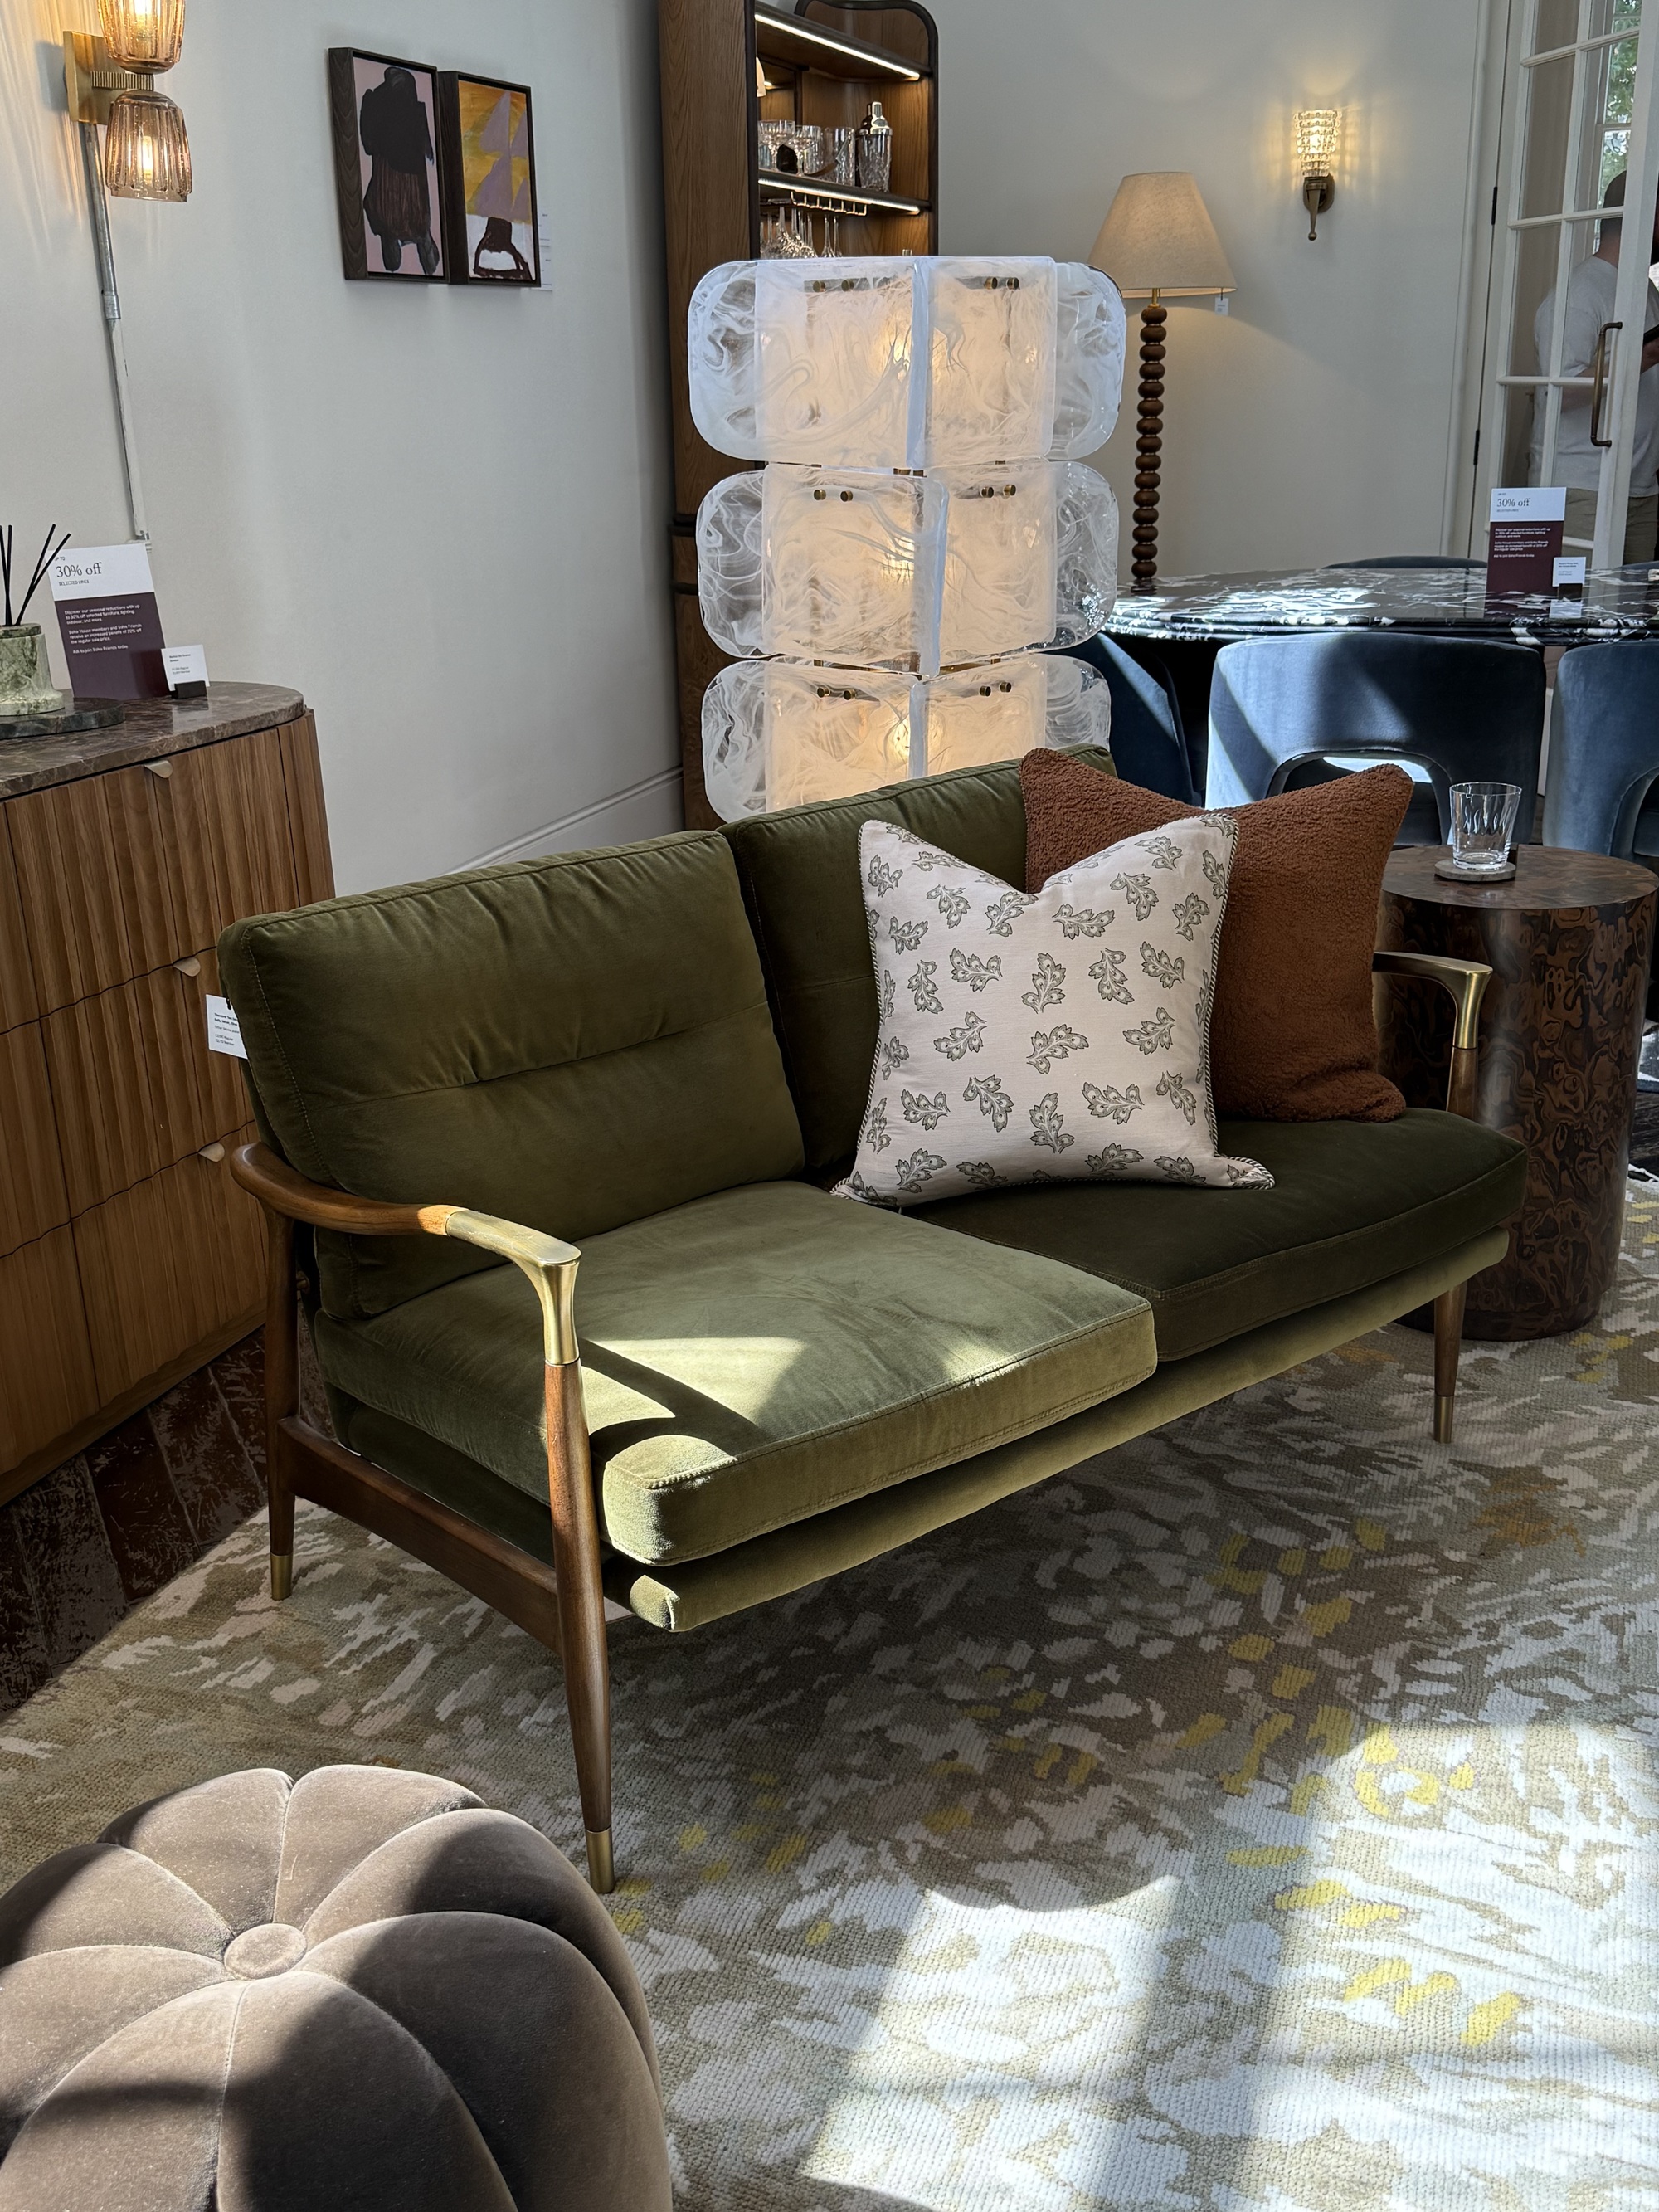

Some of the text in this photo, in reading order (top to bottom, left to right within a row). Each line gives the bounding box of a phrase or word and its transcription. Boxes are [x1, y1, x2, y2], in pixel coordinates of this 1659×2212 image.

[1497, 498, 1530, 507] 30% off
[56, 562, 102, 577] 30% off
